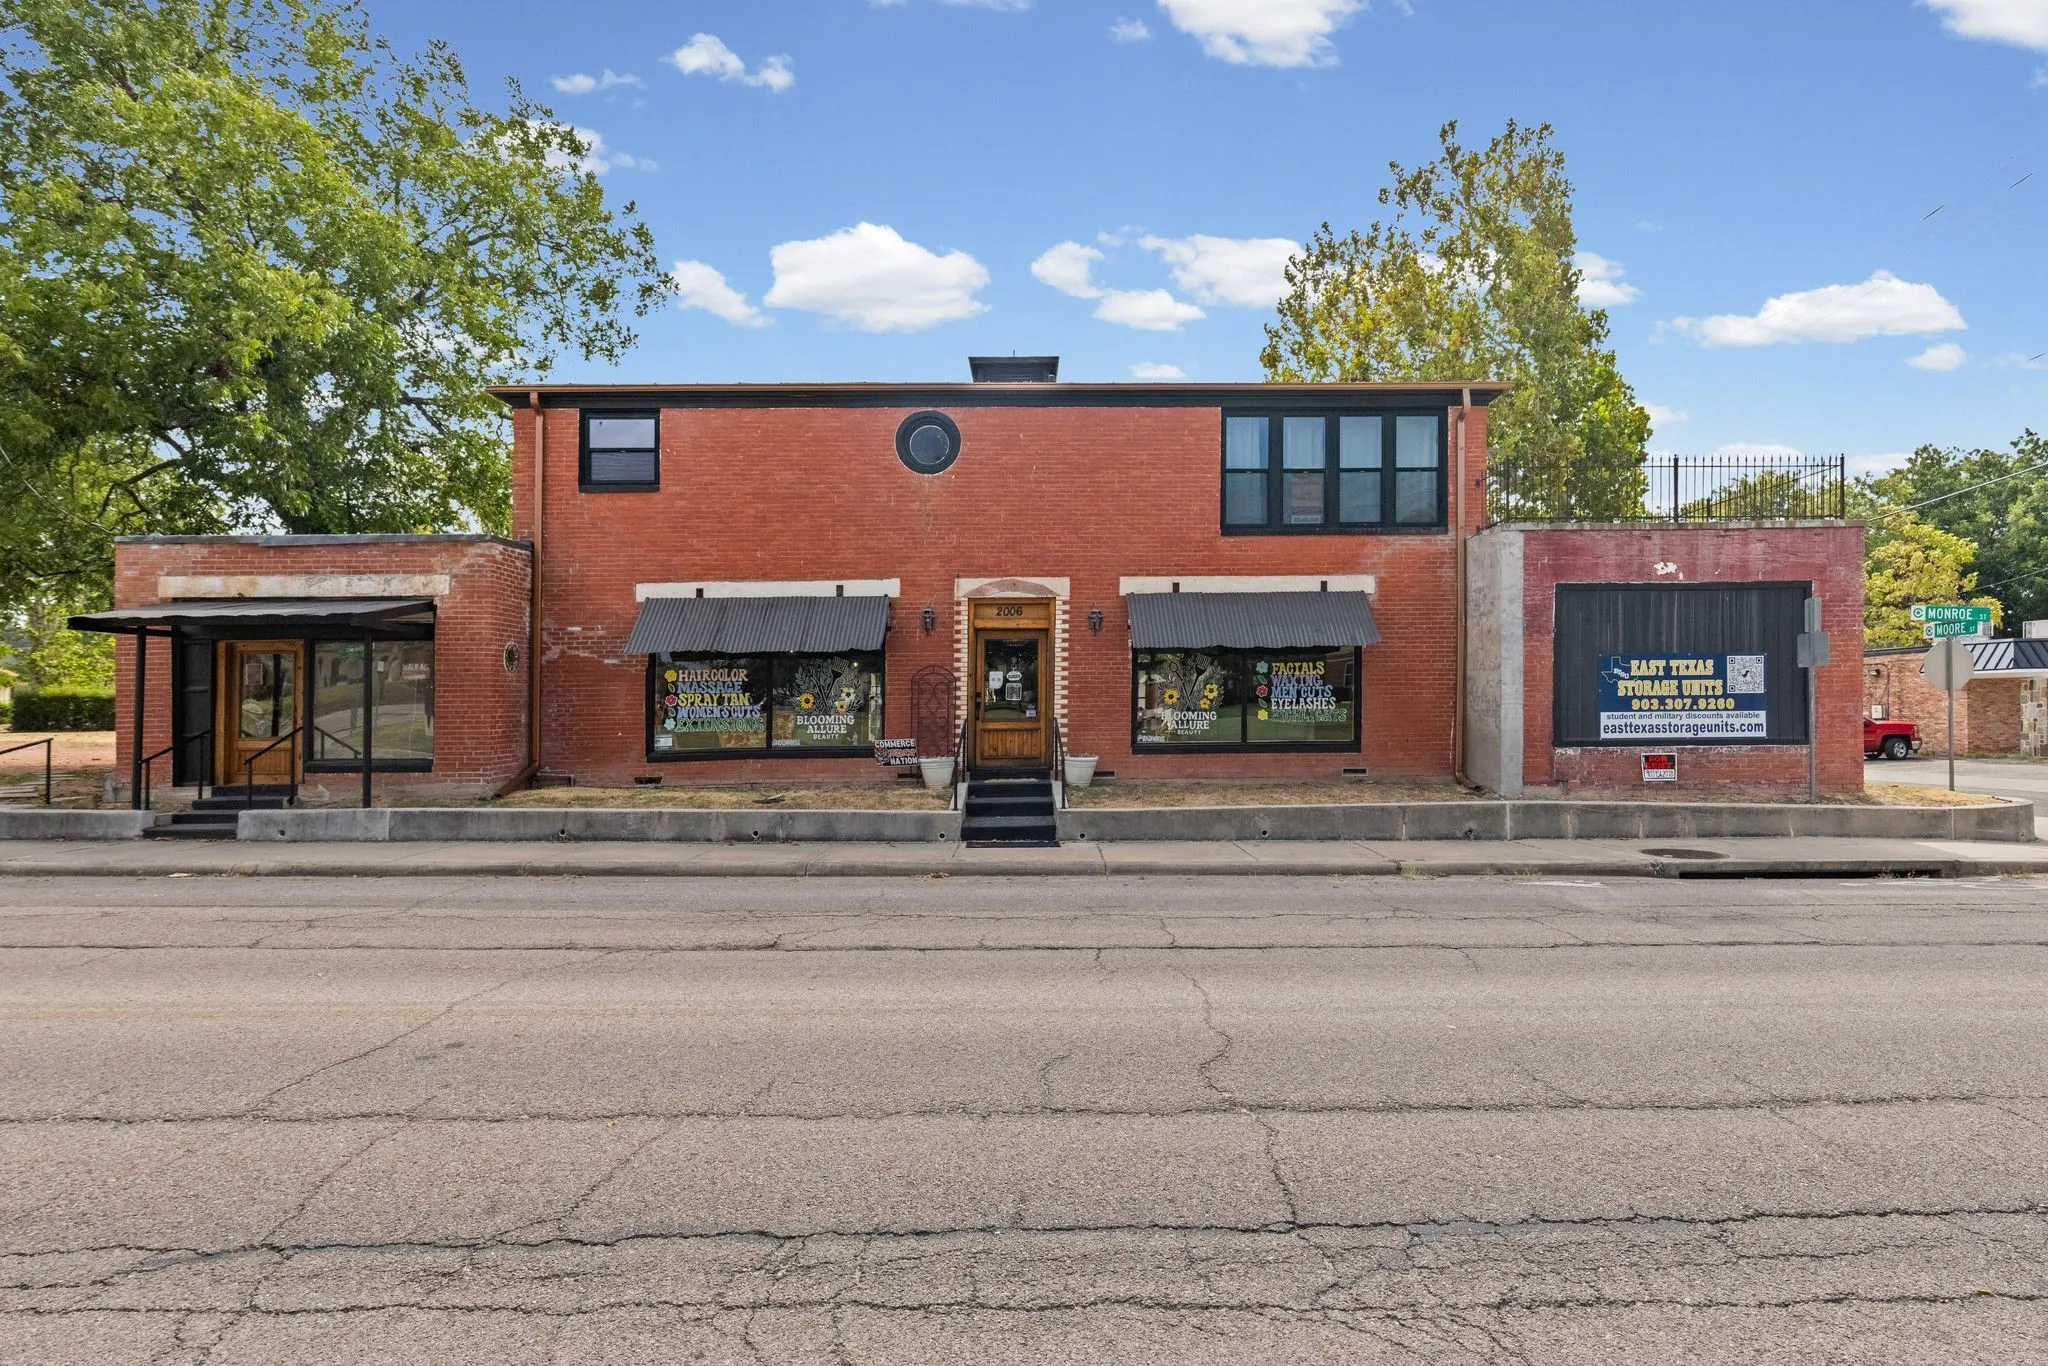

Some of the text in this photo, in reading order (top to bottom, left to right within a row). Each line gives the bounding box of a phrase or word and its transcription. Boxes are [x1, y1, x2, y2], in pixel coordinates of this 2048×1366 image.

[996, 606, 1023, 617] 2006
[1927, 608, 1973, 620] MONROE
[1936, 622, 1966, 636] MOORE
[1271, 661, 1325, 675] FACIALS
[1630, 659, 1714, 676] EAST TEXAS
[1270, 674, 1323, 687] WAXING
[677, 682, 743, 694] MASSAGE
[1301, 685, 1334, 698] CUTS
[1617, 679, 1723, 696] STORAGE UNITS
[678, 693, 750, 706] SPRAY TAN
[1271, 697, 1336, 709] EYELASHES
[1631, 697, 1736, 711] 903.307.9260
[796, 715, 855, 725] BLOOMING
[1606, 711, 1760, 721] student and military discounts available
[675, 717, 764, 732] EXTENSIONS
[806, 724, 848, 734] ALLURE
[1170, 720, 1210, 730] ALLURE
[1603, 720, 1764, 736] easttexasstorageunits.com
[874, 739, 916, 748] COMMERCE
[890, 756, 918, 765] NATION
